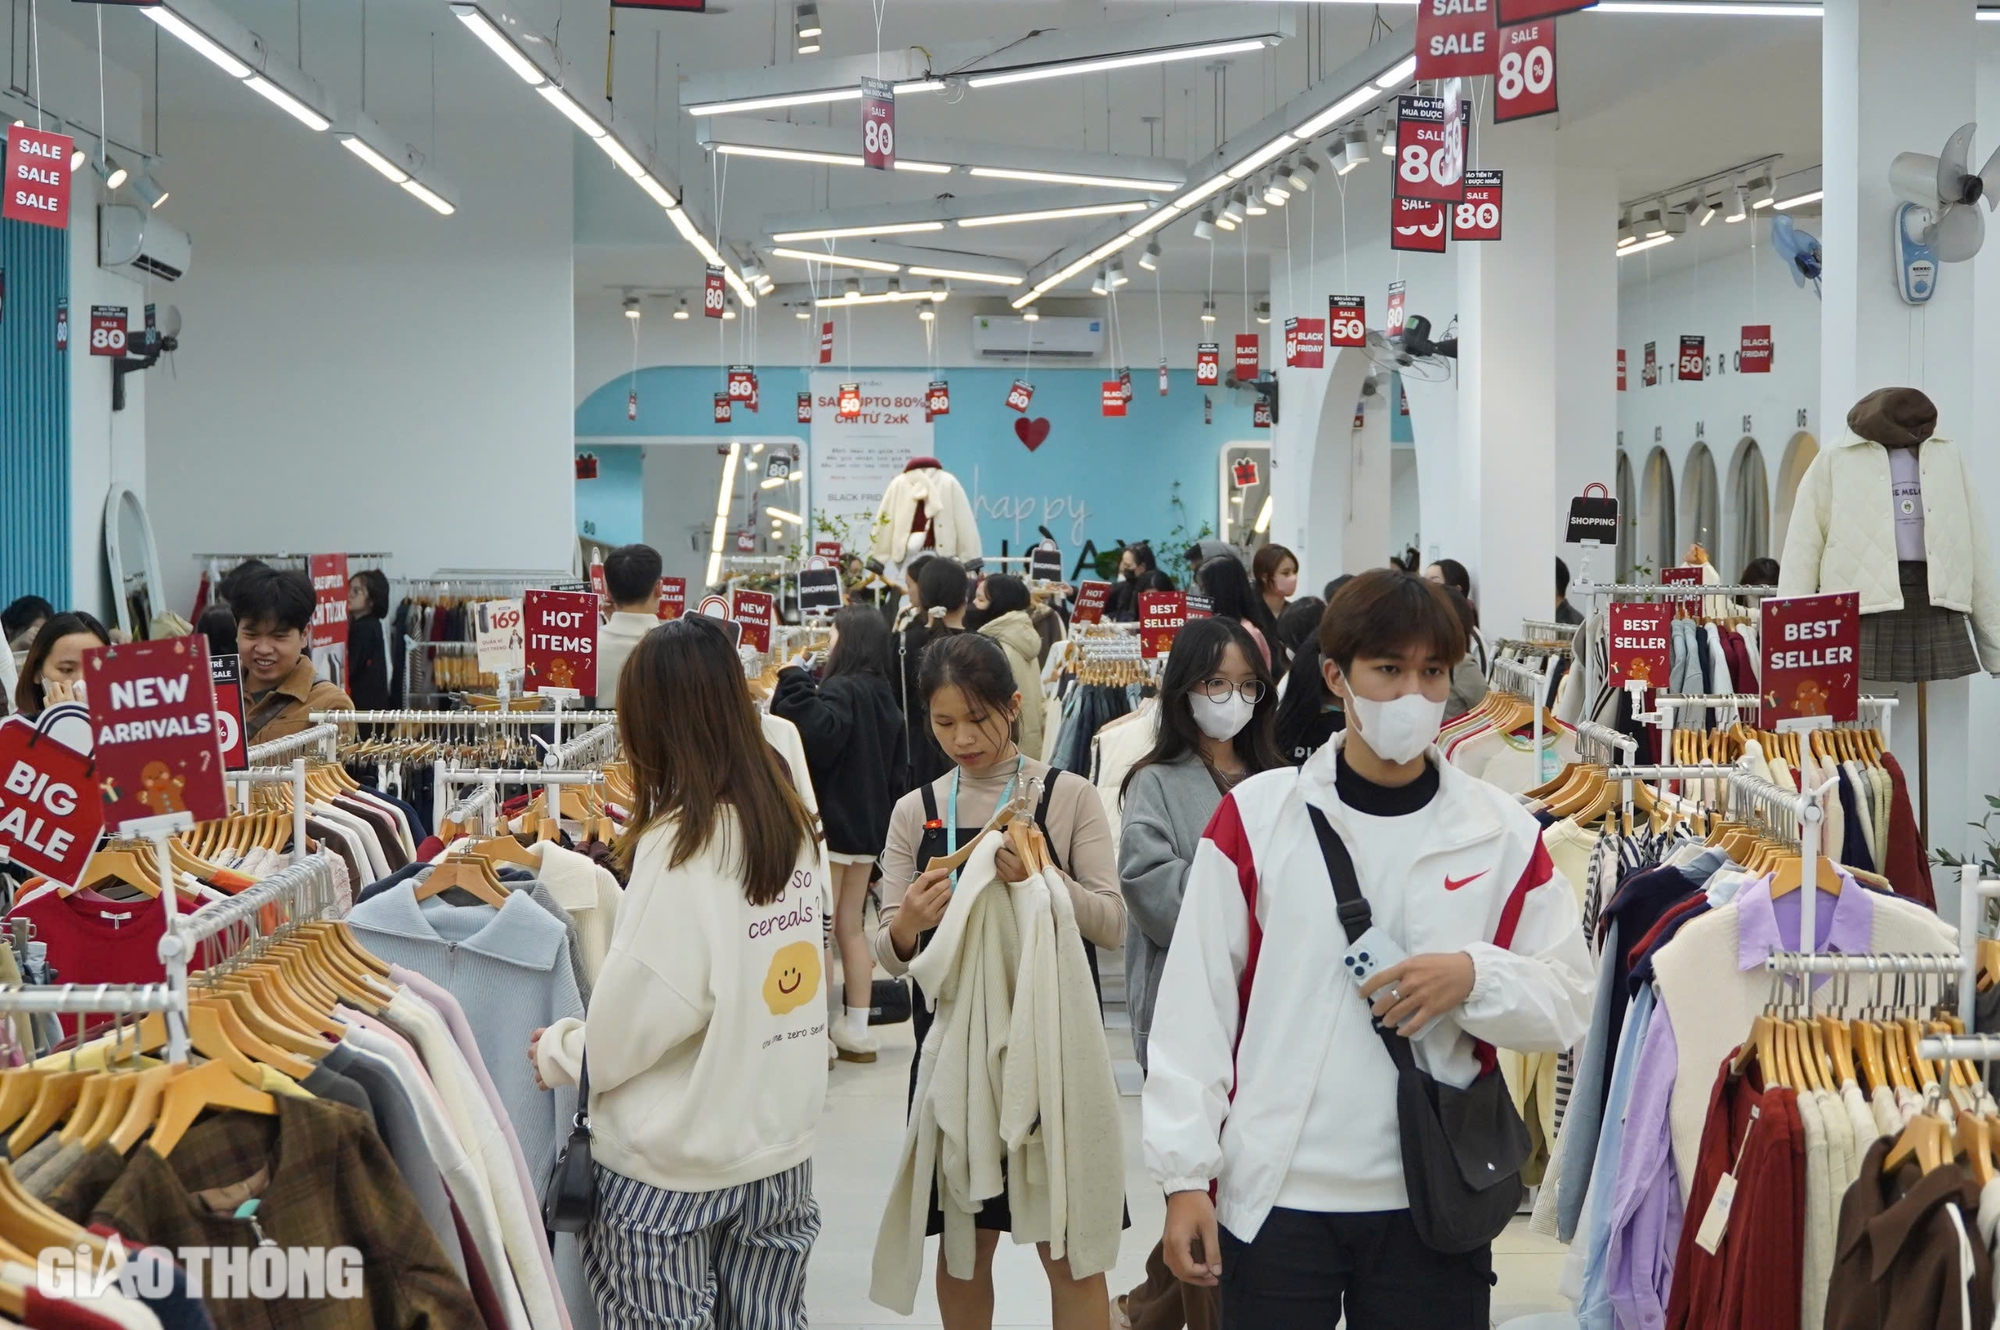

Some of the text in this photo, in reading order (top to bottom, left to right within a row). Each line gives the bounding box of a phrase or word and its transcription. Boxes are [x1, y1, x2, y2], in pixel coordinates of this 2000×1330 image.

[1433, 0, 1487, 16] SALE
[1511, 27, 1538, 44] SALE
[1430, 32, 1485, 56] SALE
[871, 106, 886, 117] SALE
[1402, 108, 1418, 117] MUA
[19, 139, 62, 160] SALE
[18, 165, 60, 186] SALE
[16, 191, 58, 212] SALE
[1467, 192, 1489, 200] SALE
[1401, 199, 1431, 211] SALE
[706, 288, 723, 309] 80
[1387, 306, 1403, 328] 80
[1298, 332, 1323, 340] BLACK
[1743, 338, 1769, 346] BLACK
[1297, 344, 1322, 352] FRIDAY
[1742, 350, 1769, 358] FRIDAY
[1198, 362, 1217, 379] 80
[1680, 356, 1702, 373] 50
[729, 381, 752, 396] 80
[840, 398, 860, 413] 50
[931, 396, 948, 410] 80
[1009, 391, 1028, 408] 80
[798, 406, 811, 419] 50
[828, 493, 858, 501] BLACK
[973, 463, 1092, 546] happy
[1570, 516, 1616, 527] SHOPPING
[801, 584, 837, 594] SHOPPING
[1086, 589, 1104, 598] HOT
[741, 603, 765, 615] NEW
[1078, 599, 1105, 608] ITEMS
[1150, 605, 1178, 614] BEST
[491, 611, 520, 629] 169
[542, 610, 584, 628] HOT
[735, 615, 769, 626] ARRIVALS
[1144, 618, 1184, 628] SELLER
[1623, 619, 1658, 631] BEST
[1784, 619, 1842, 642] BEST
[532, 633, 592, 654] ITEMS
[1614, 637, 1666, 649] SELLER
[1770, 646, 1853, 670] SELLER
[213, 670, 231, 678] SALE
[110, 673, 189, 710] NEW
[98, 713, 212, 745] ARRIVALS
[4, 760, 78, 816] BIG
[0, 797, 75, 863] ALE
[787, 1029, 807, 1039] zero
